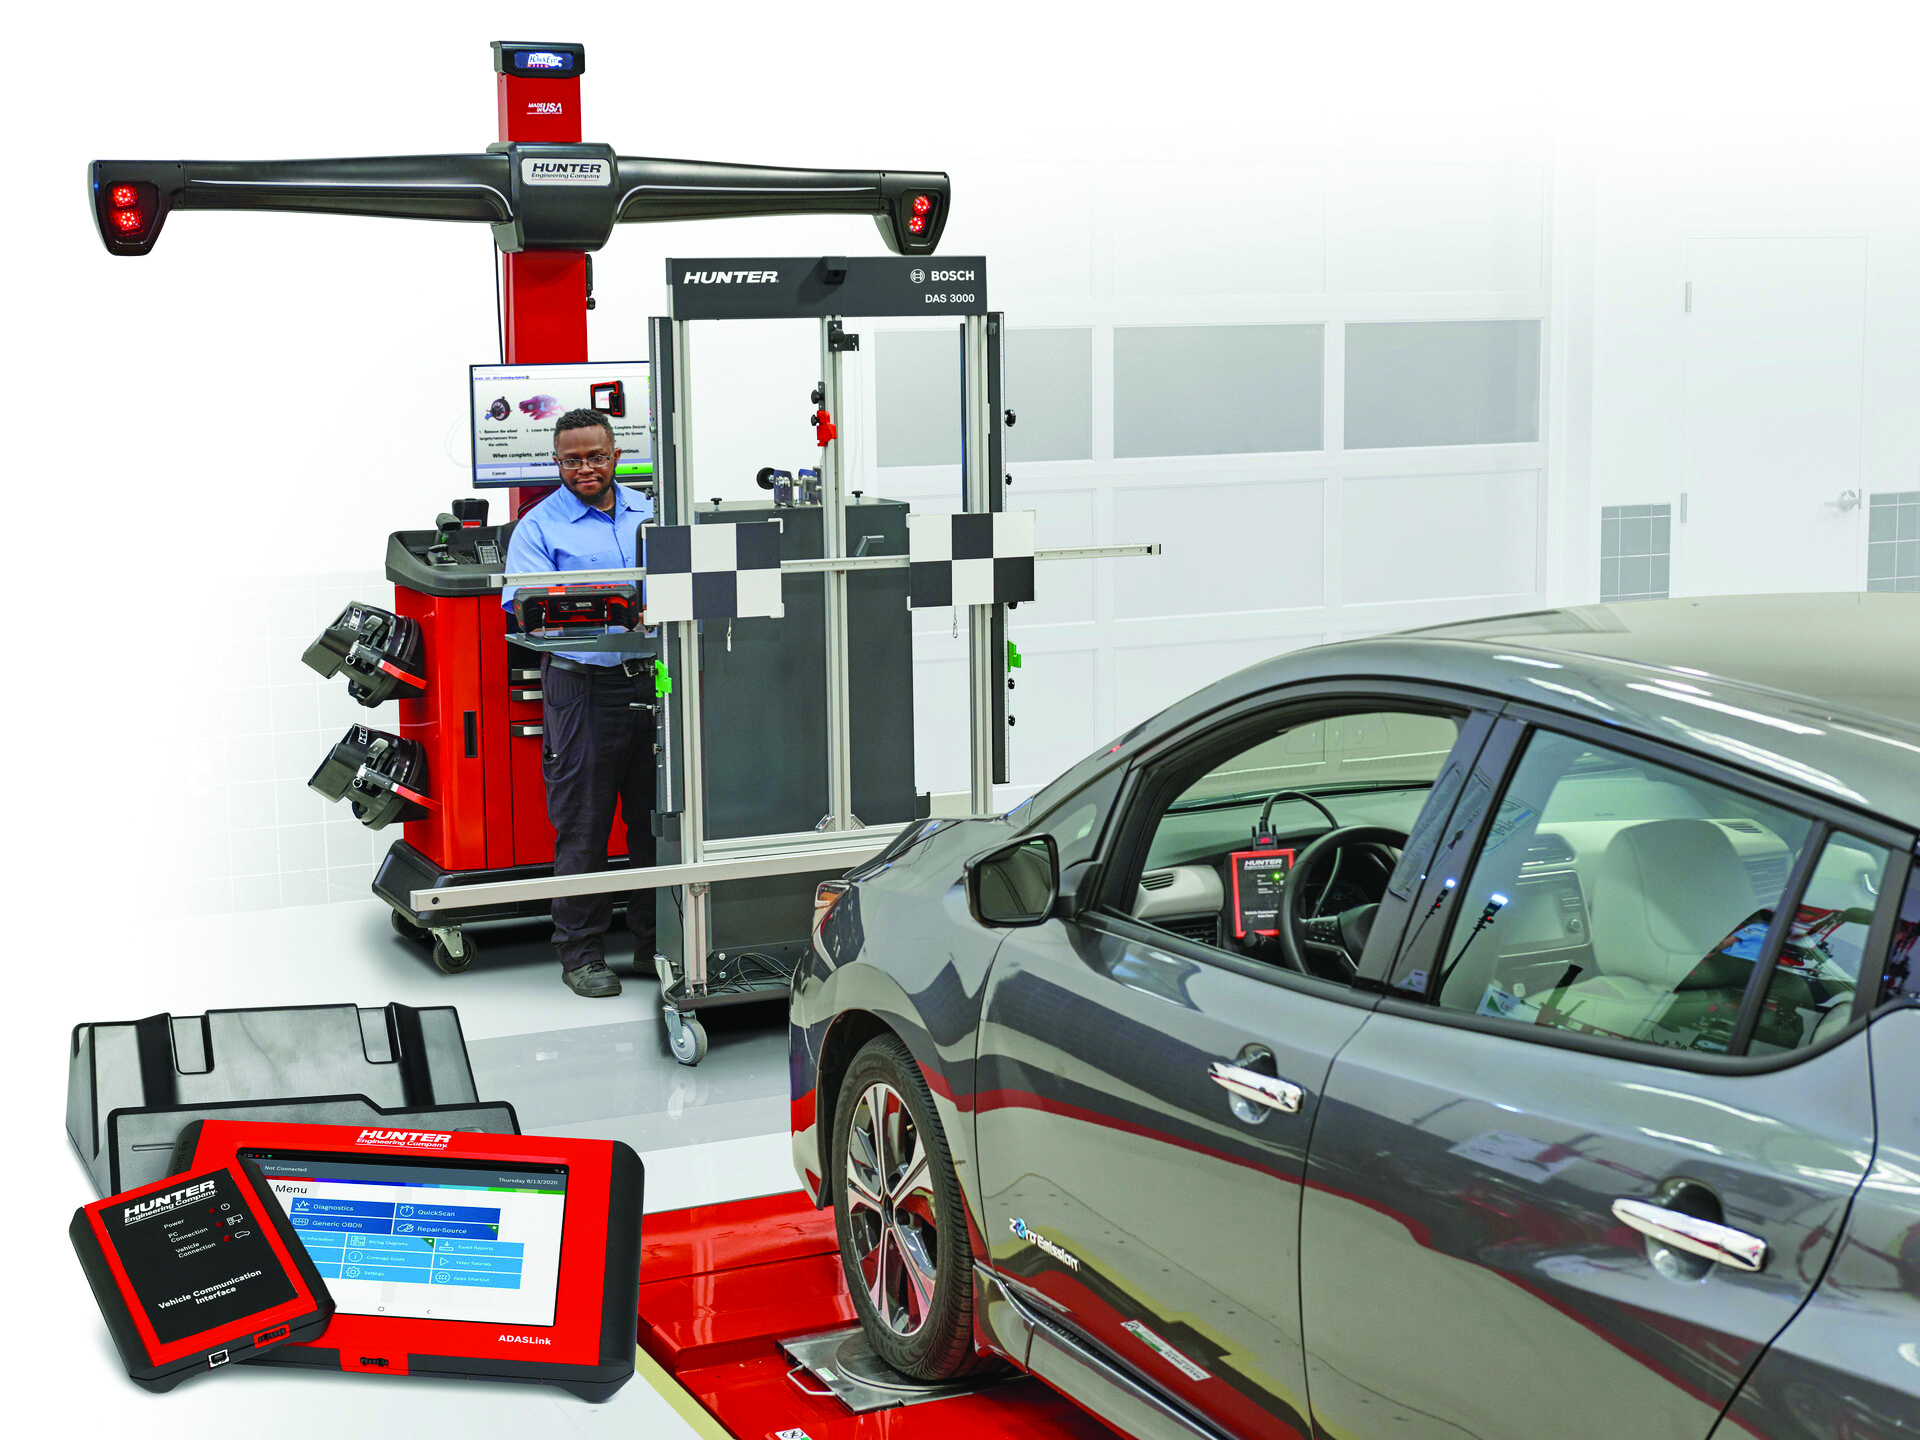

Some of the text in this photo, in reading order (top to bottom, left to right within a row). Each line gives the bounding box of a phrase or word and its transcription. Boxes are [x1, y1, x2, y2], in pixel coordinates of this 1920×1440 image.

[542, 102, 562, 113] USA
[532, 163, 602, 173] HUNTER
[531, 172, 601, 181] Engineering Company
[683, 271, 779, 284] HUNTER
[931, 270, 975, 281] BOSCH
[925, 293, 975, 303] DAS 3000
[1244, 858, 1283, 867] HUNTER
[358, 1129, 452, 1144] HUNTER
[356, 1137, 406, 1148] Engineering
[498, 1177, 525, 1185] Thursday
[275, 1184, 308, 1194] Menu
[124, 1180, 216, 1218] HUNTER
[124, 1202, 175, 1224] Engineering
[313, 1203, 354, 1212] Diagnostics
[417, 1209, 455, 1217] QuickScan
[163, 1219, 185, 1229] Power
[312, 1220, 340, 1228] Generic
[168, 1231, 179, 1239] PC
[170, 1227, 209, 1243] Connection
[175, 1242, 200, 1254] Vehicle
[178, 1242, 217, 1259] Connection
[158, 1270, 262, 1309] Vehicle Communication
[195, 1286, 237, 1305] Interface
[498, 1334, 552, 1346] ADASLink
